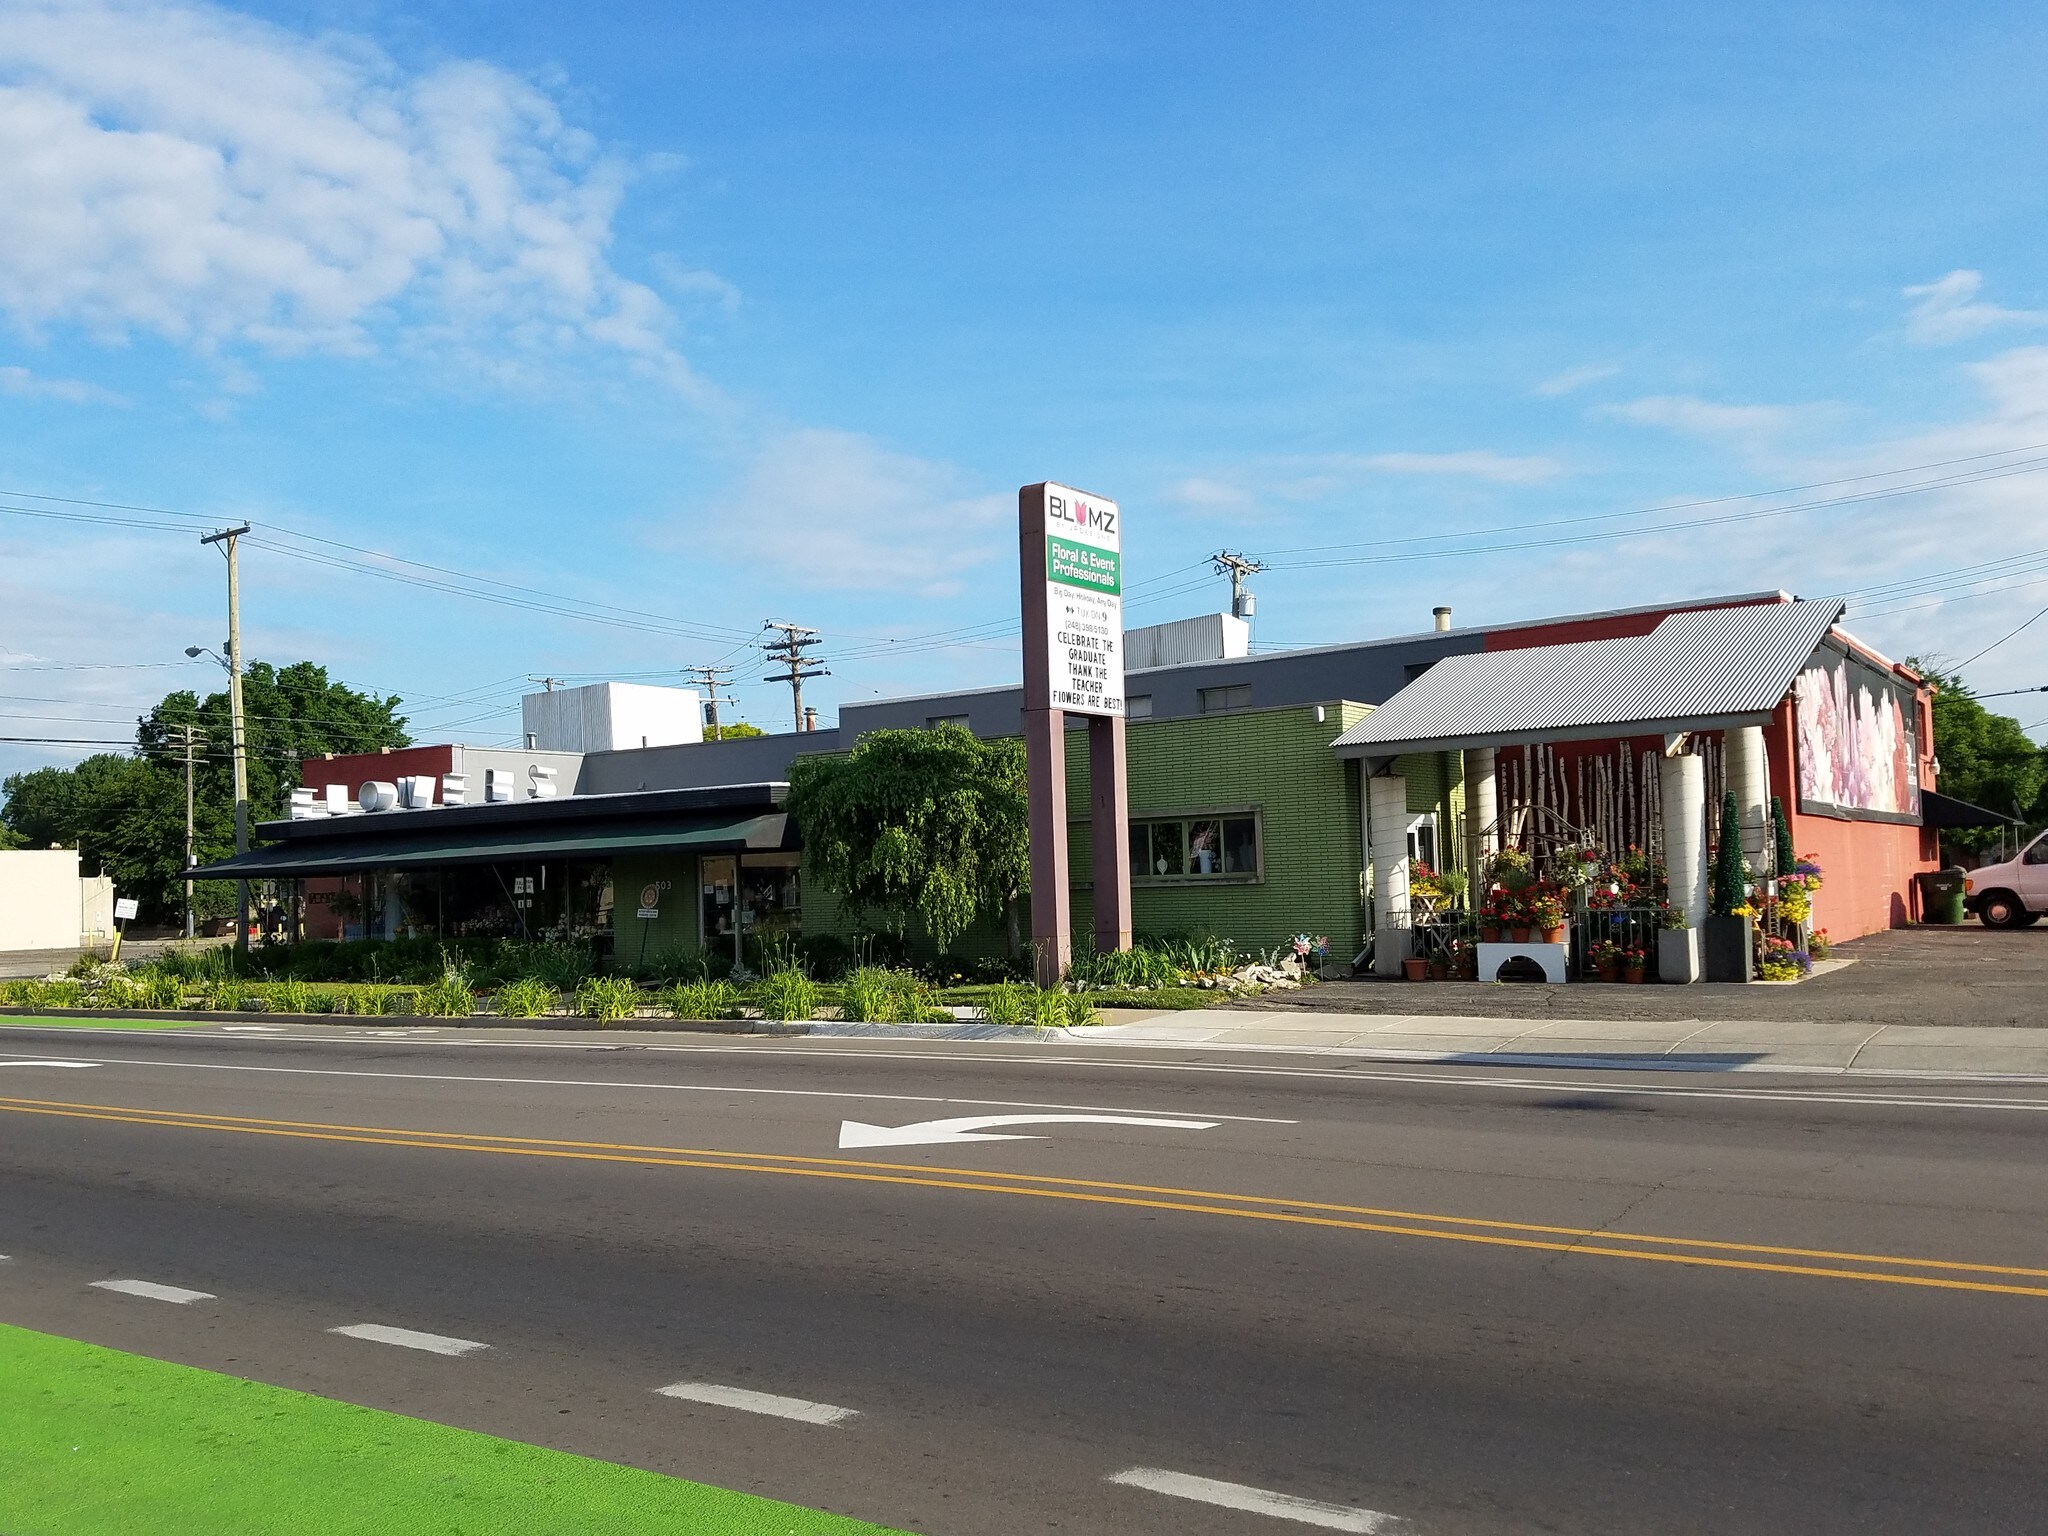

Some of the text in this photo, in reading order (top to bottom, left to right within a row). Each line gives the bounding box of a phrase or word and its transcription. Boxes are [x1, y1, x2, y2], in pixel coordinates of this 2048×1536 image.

[1052, 543, 1115, 572] Floral & Event
[1053, 559, 1115, 587] Professionals
[1057, 631, 1114, 653] CELEBRATE THE
[1068, 647, 1106, 665] GRADUATE
[1068, 662, 1108, 680] THANK THE
[1072, 677, 1103, 694] TEACHER
[1087, 694, 1100, 708] ARE
[1103, 696, 1123, 711] BEST!
[655, 880, 672, 890] 503
